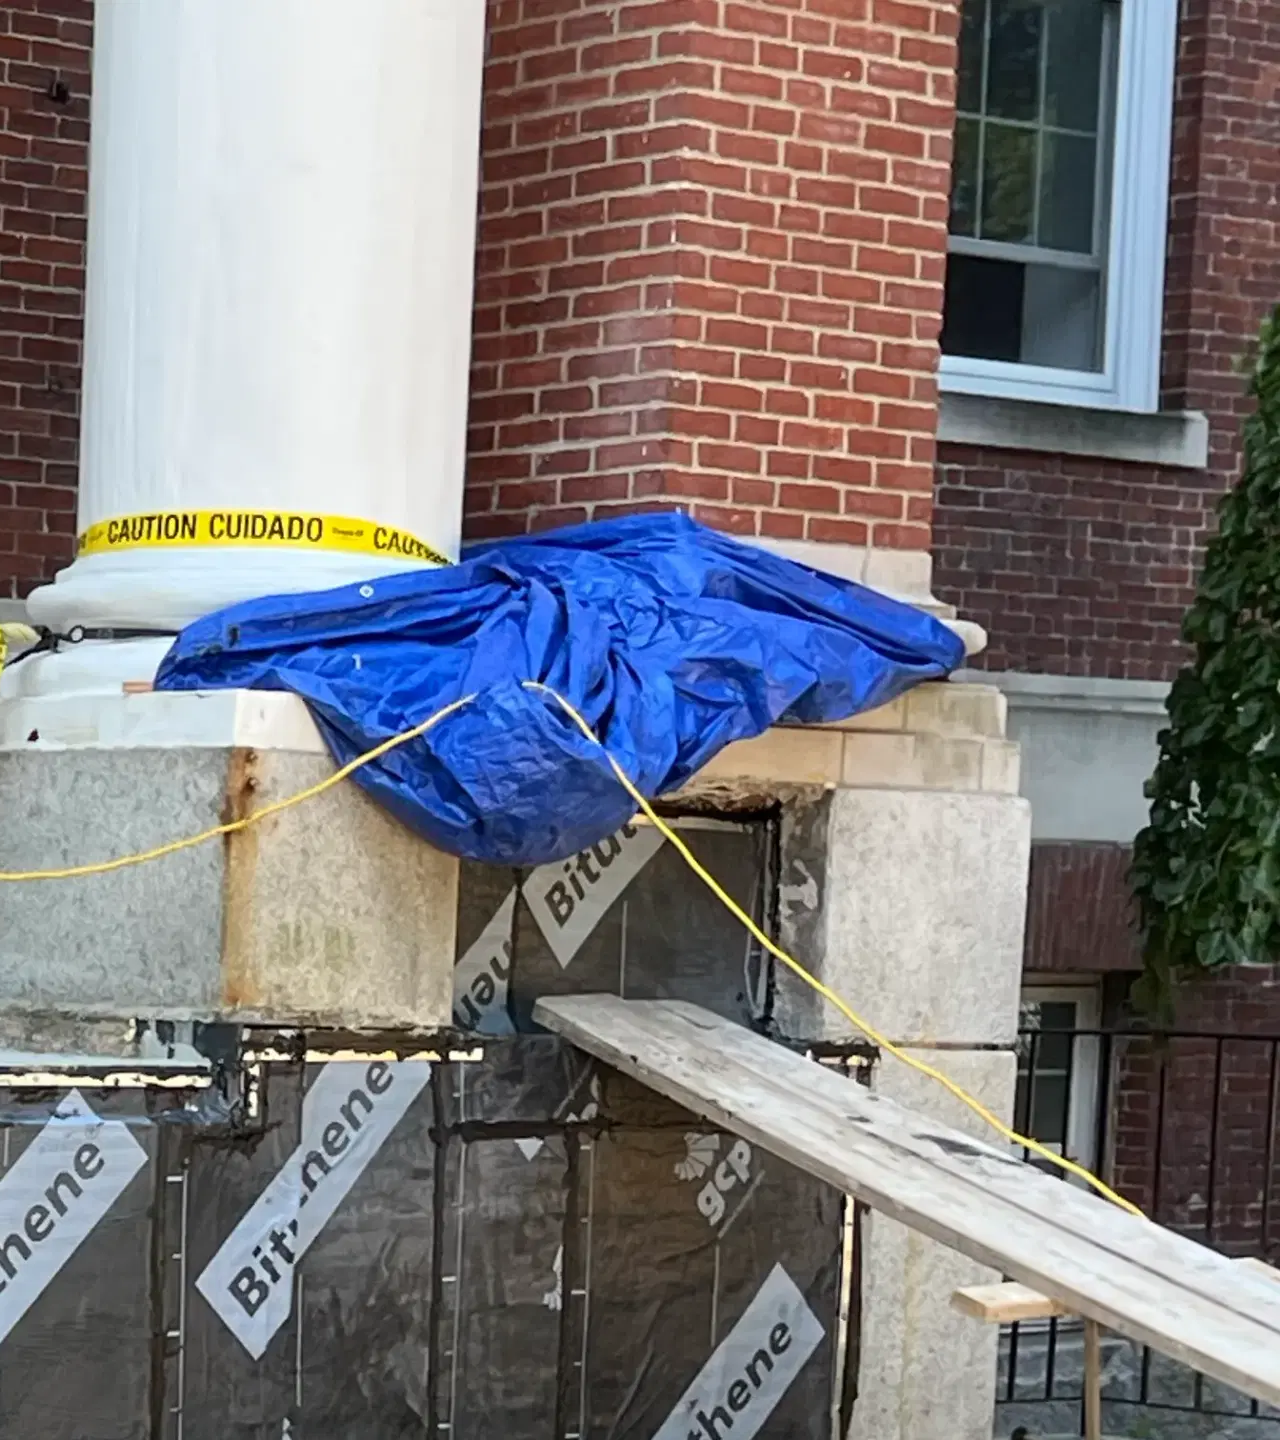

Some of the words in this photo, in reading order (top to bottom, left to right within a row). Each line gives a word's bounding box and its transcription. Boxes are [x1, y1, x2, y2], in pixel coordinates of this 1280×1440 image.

[107, 514, 197, 545] CAUTION
[209, 514, 324, 542] CUIDADO
[373, 526, 452, 567] CAUT
[696, 1140, 751, 1226] gcp
